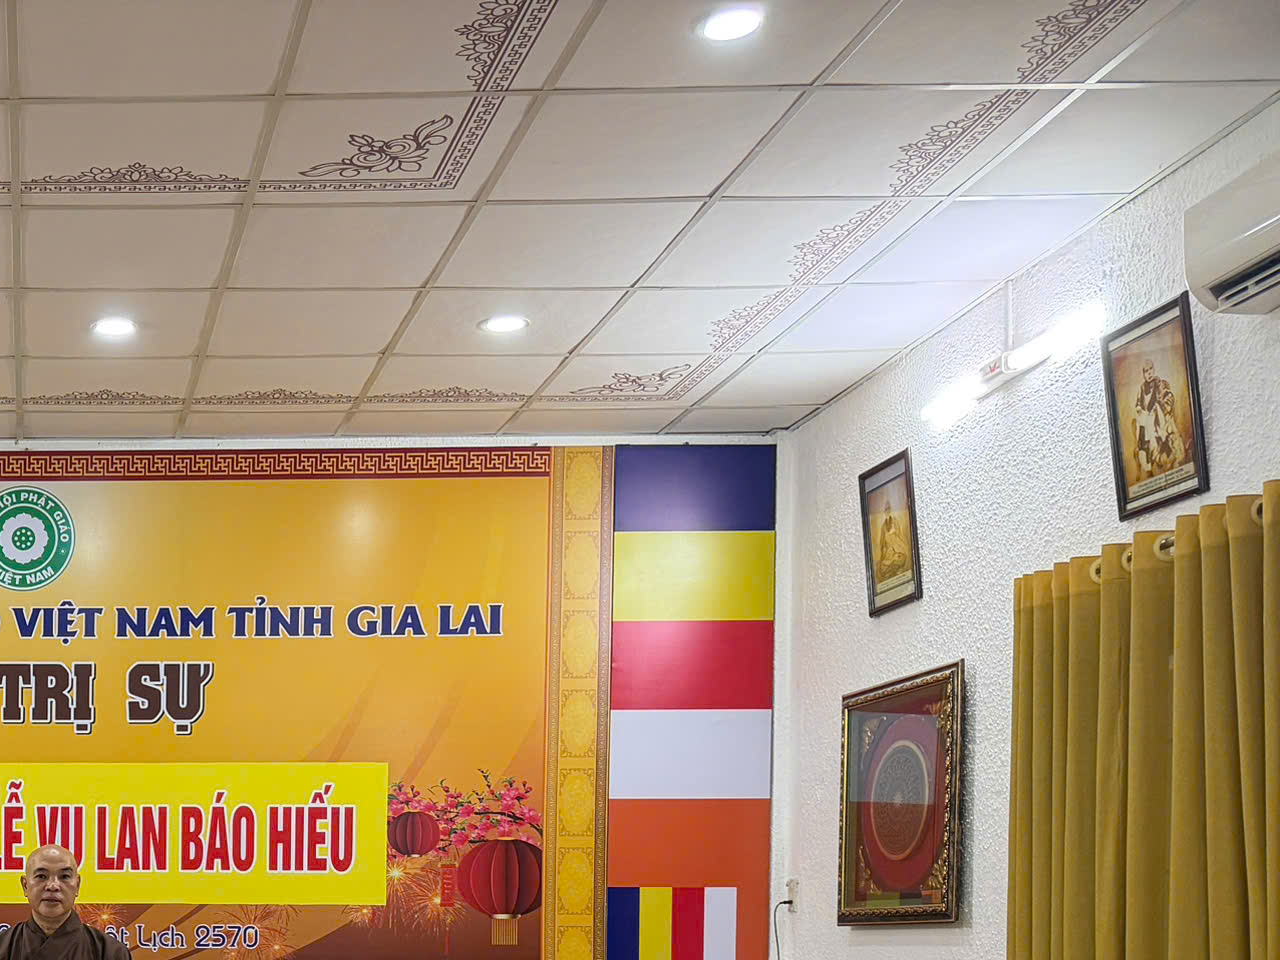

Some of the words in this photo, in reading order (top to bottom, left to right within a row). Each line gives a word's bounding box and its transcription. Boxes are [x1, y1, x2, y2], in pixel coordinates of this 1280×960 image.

[20, 492, 54, 511] PHẬT
[53, 511, 70, 542] GIÁO
[26, 566, 55, 585] NAM
[12, 600, 105, 646] VIỆT
[114, 606, 216, 639] NAM
[227, 597, 334, 638] TỈNH
[346, 605, 427, 637] GIA
[437, 604, 503, 637] LAI
[126, 662, 214, 735] SỰ
[35, 805, 85, 872] VU
[95, 805, 168, 872] LAN
[180, 791, 257, 872] BÁO
[267, 783, 356, 873] HIẾU
[136, 923, 186, 952] Lịch
[195, 924, 259, 949] 2570
